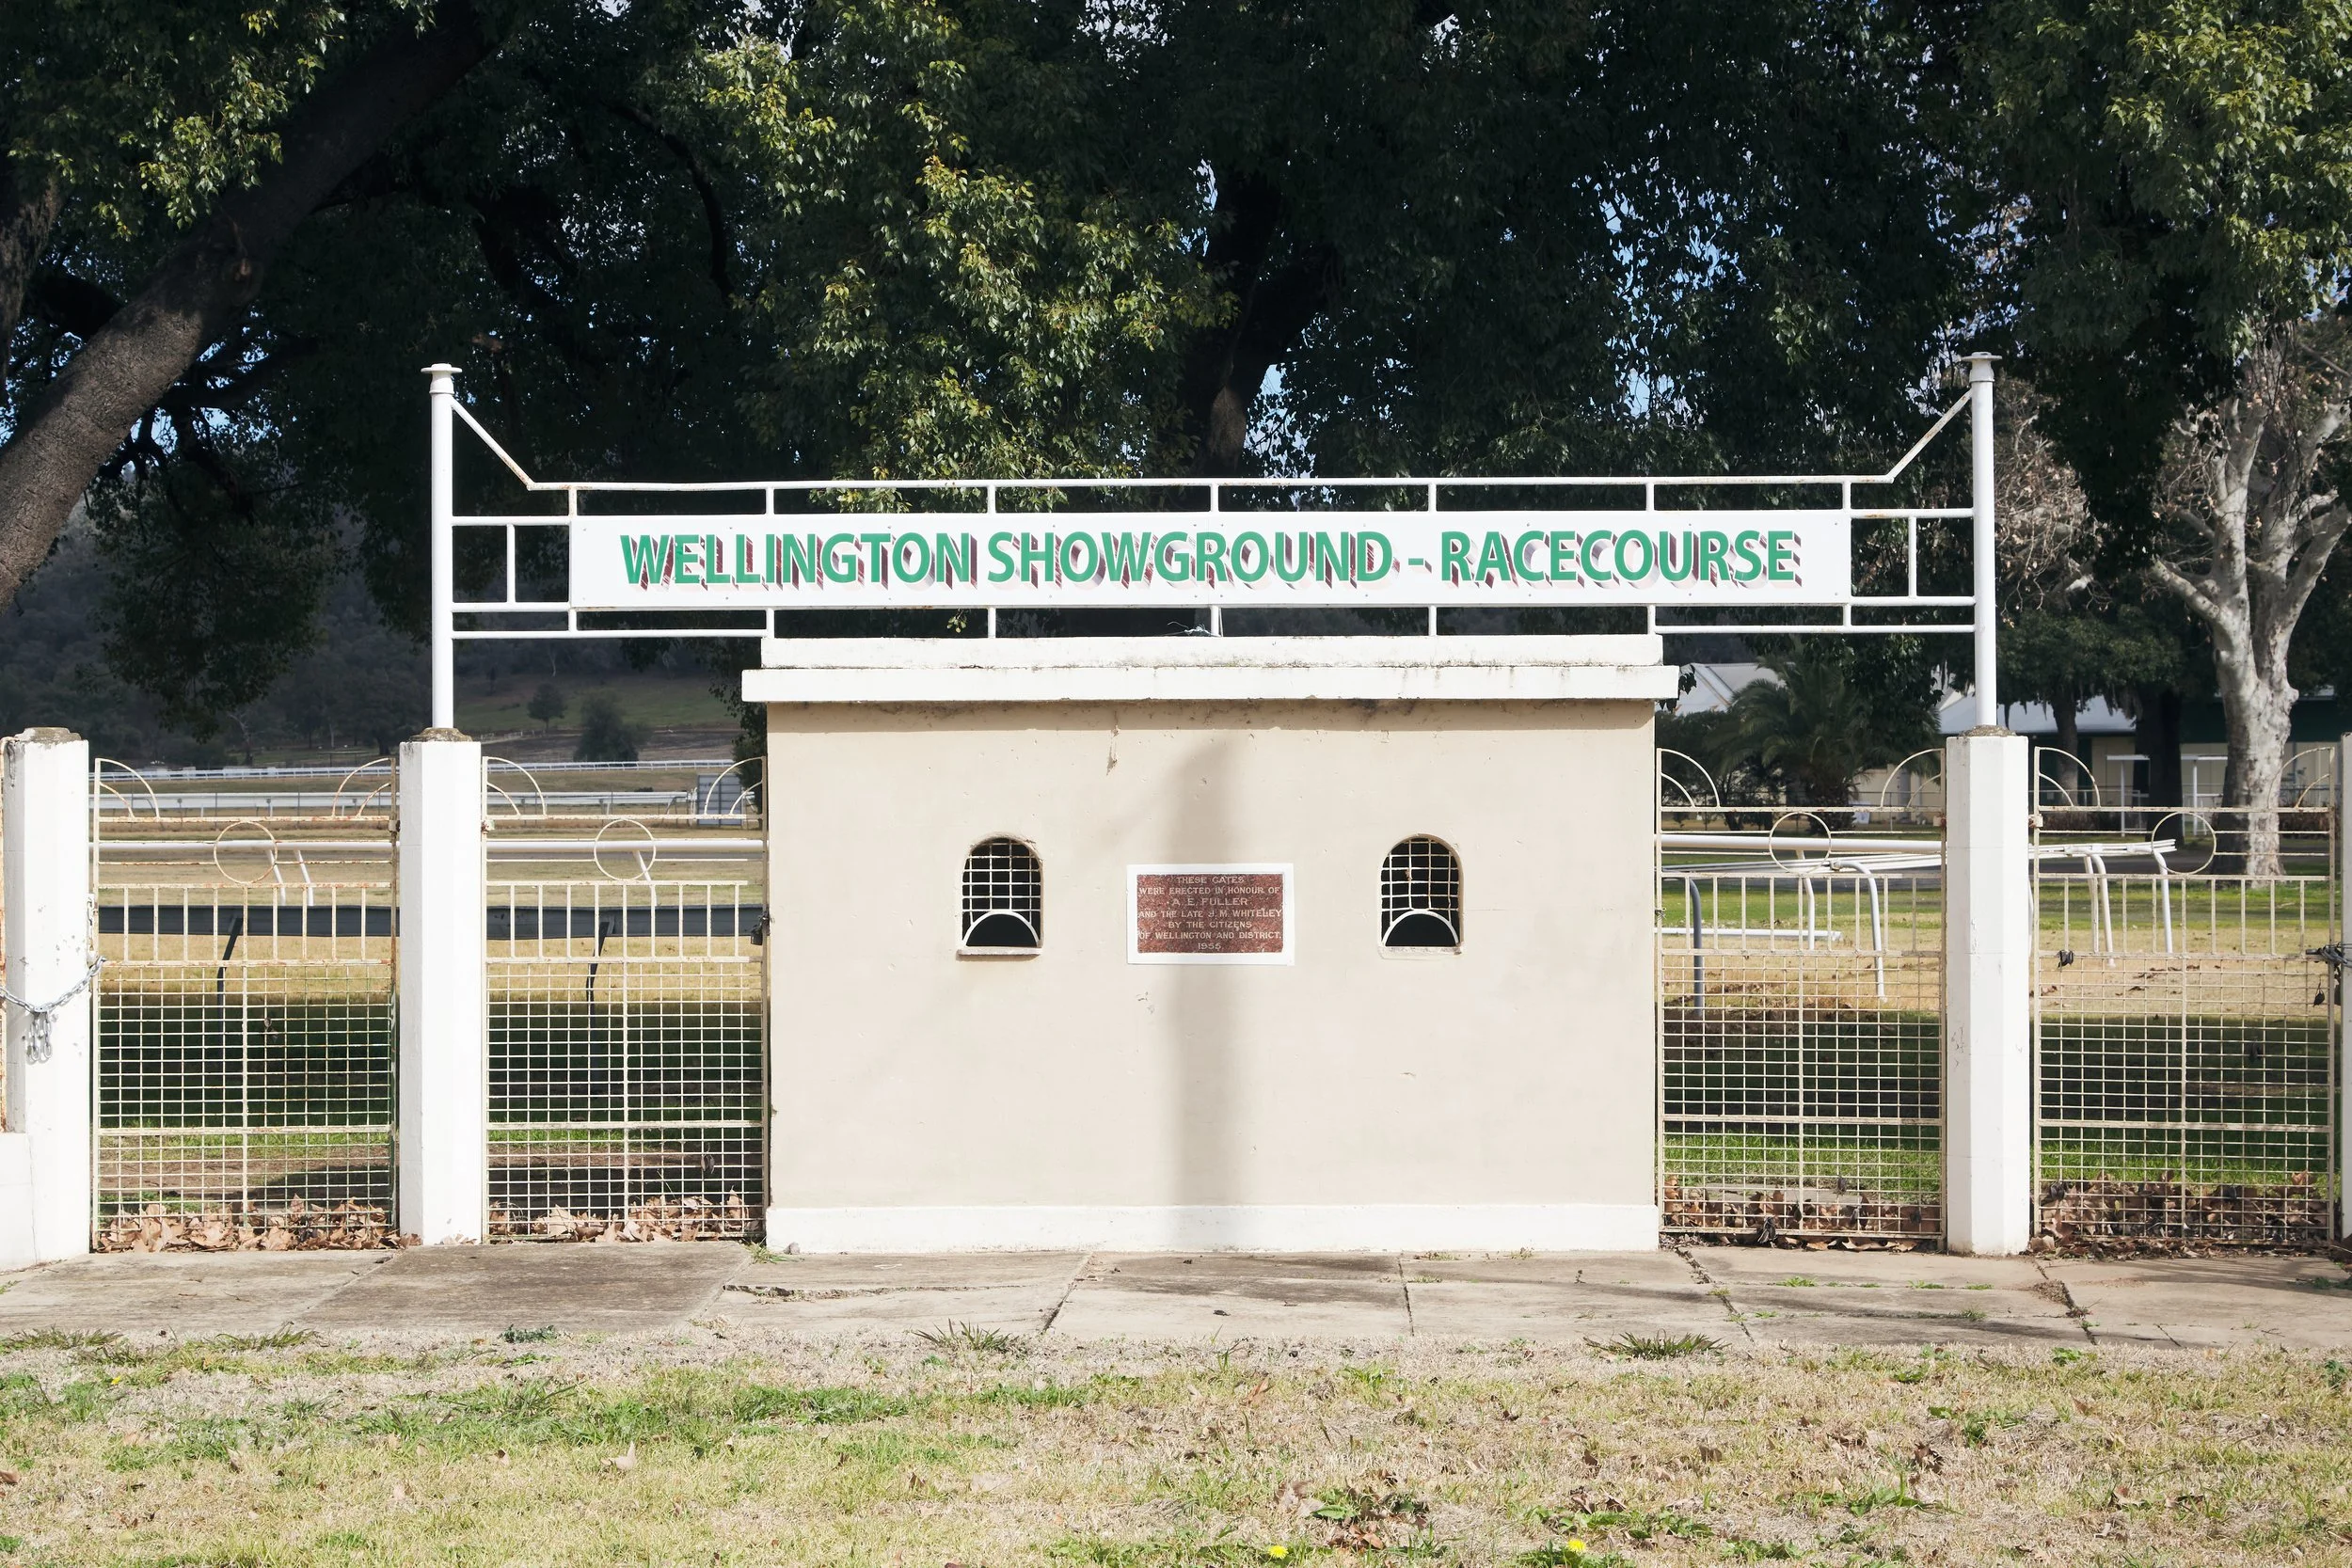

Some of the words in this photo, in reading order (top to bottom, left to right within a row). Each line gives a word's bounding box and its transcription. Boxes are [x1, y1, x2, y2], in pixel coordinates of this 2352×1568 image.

[620, 532, 977, 591] WELLINGTON
[988, 531, 1400, 590] SHOWGROUND
[1441, 530, 1802, 589] RACECOURSE
